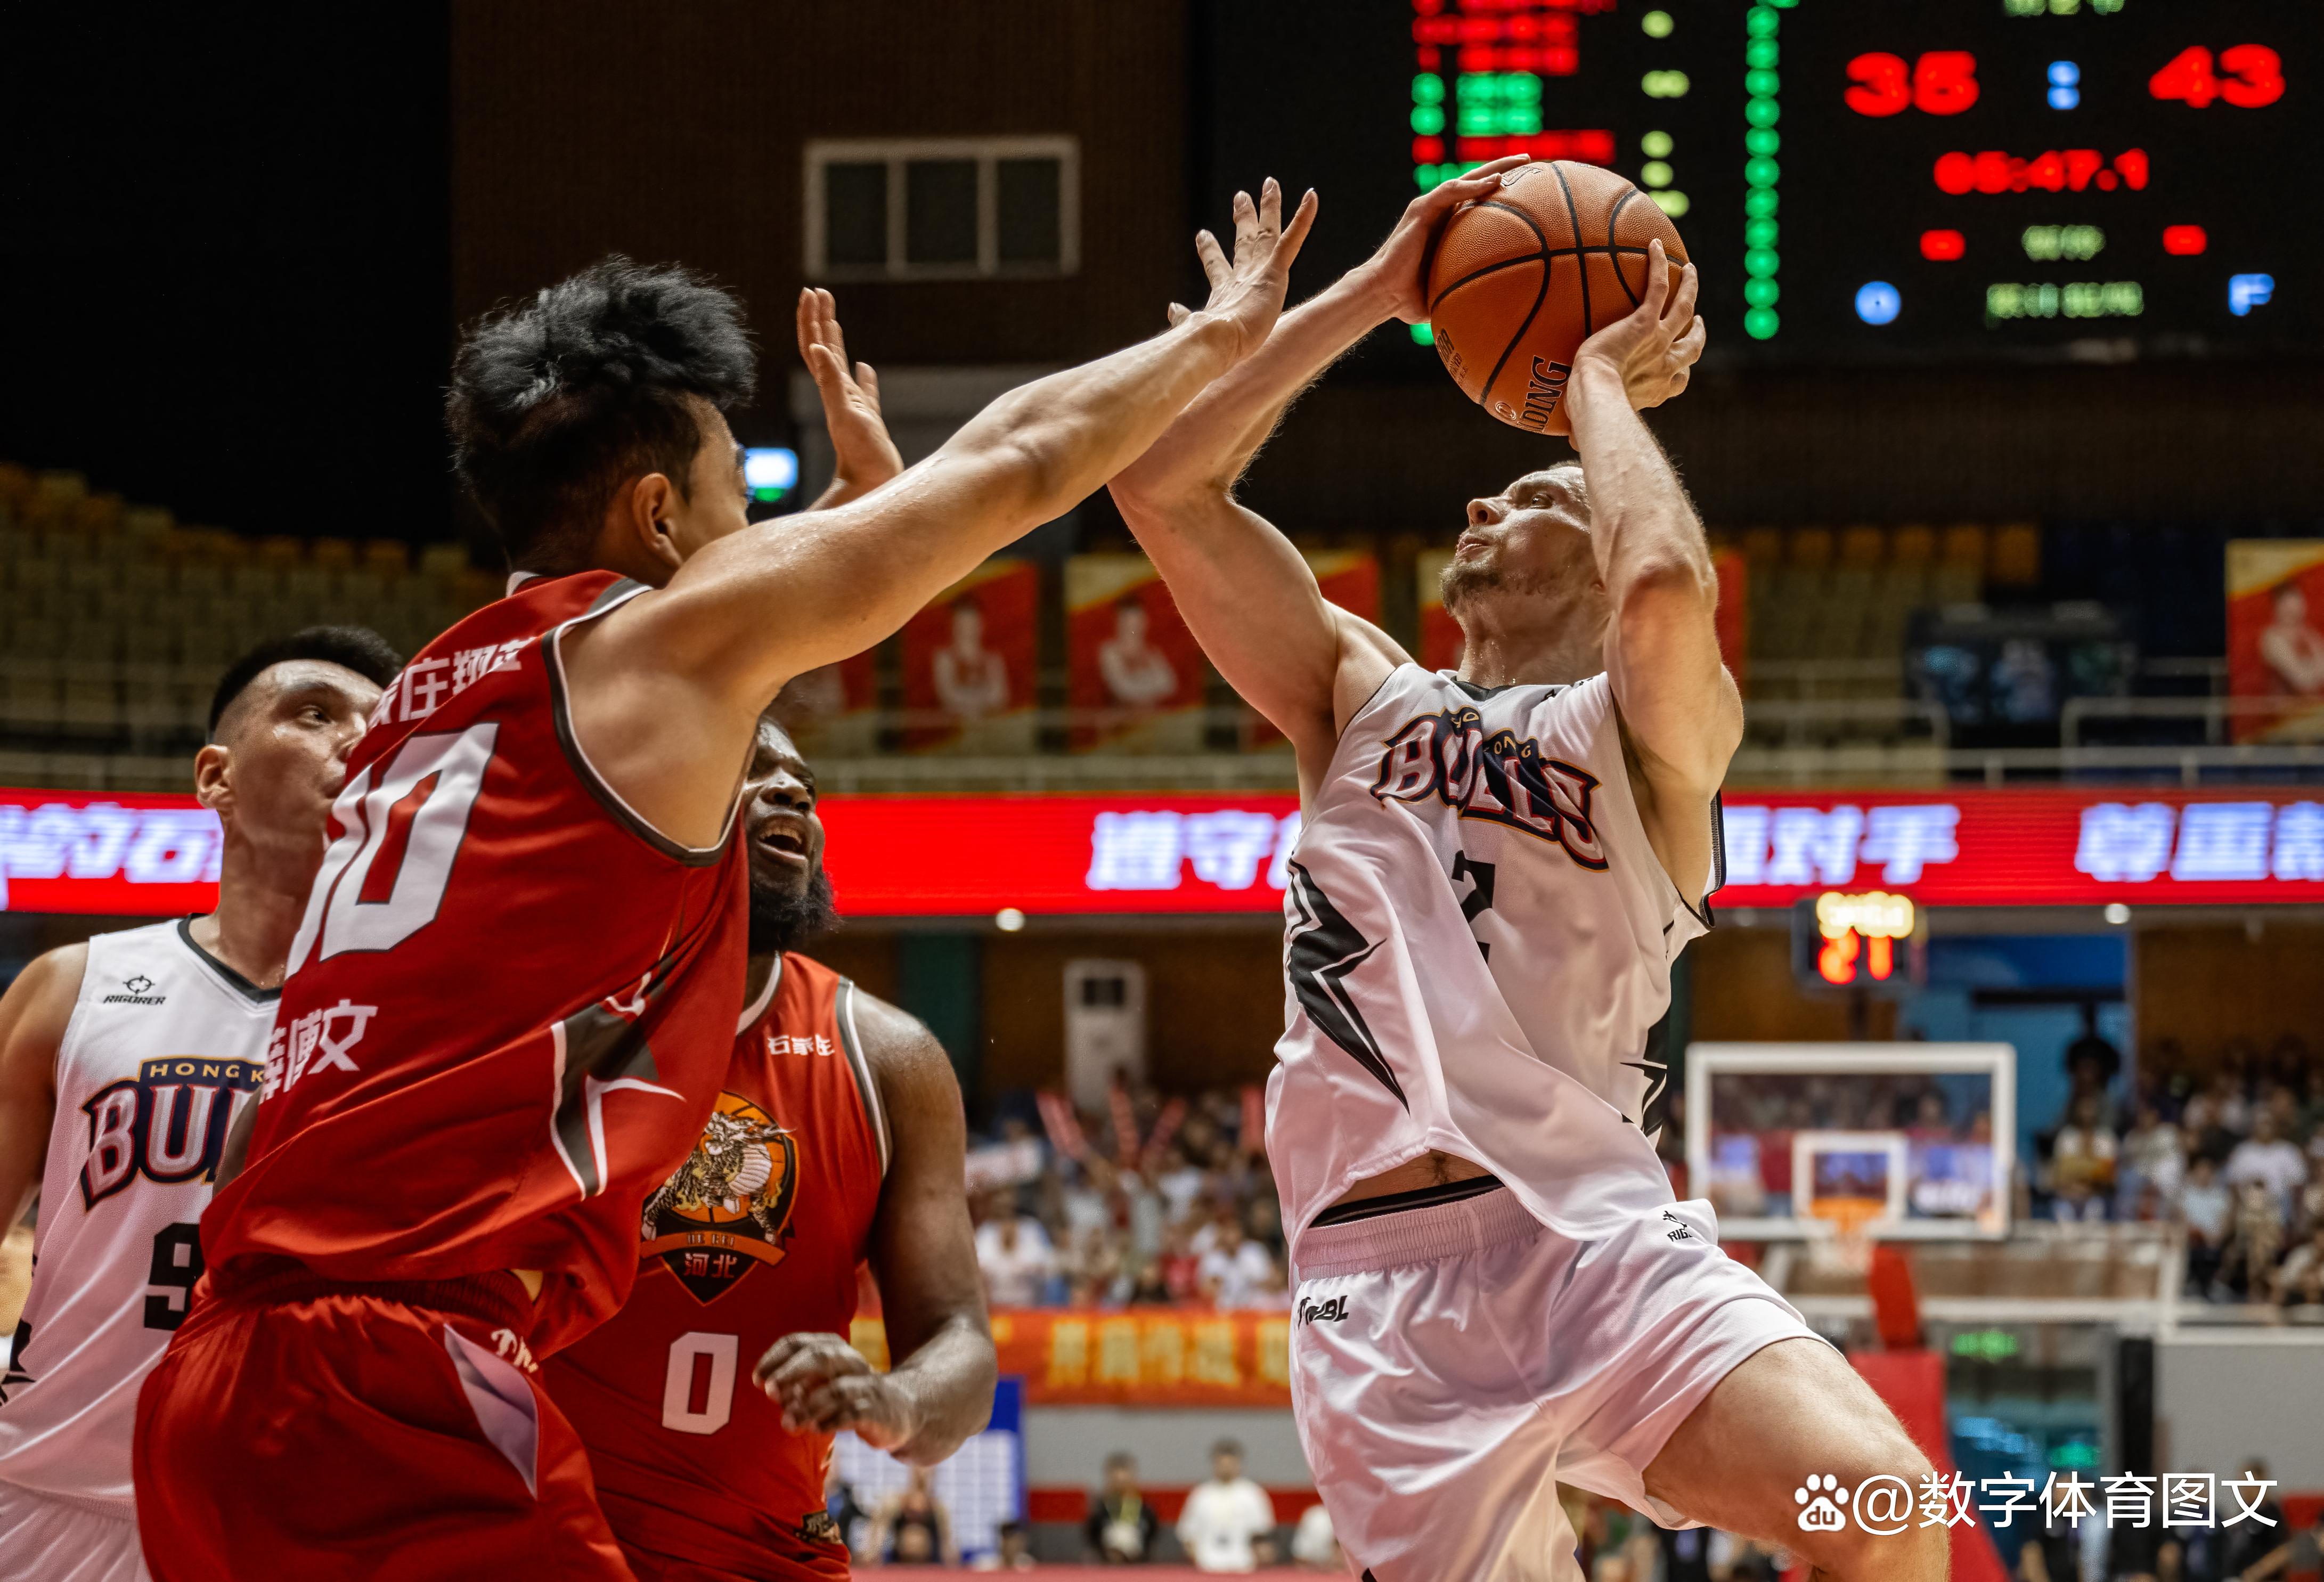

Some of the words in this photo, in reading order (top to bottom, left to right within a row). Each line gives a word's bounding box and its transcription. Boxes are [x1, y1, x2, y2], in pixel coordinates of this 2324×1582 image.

[2149, 44, 2286, 108] 43
[1373, 717, 1607, 865] BULLS
[284, 721, 501, 980] 10
[103, 994, 166, 1006] RIGORER
[150, 1063, 240, 1079] HONG
[767, 1032, 835, 1056] 石家庄
[144, 1223, 205, 1331] 9
[684, 1252, 738, 1278] 河北
[662, 1331, 739, 1436] 0
